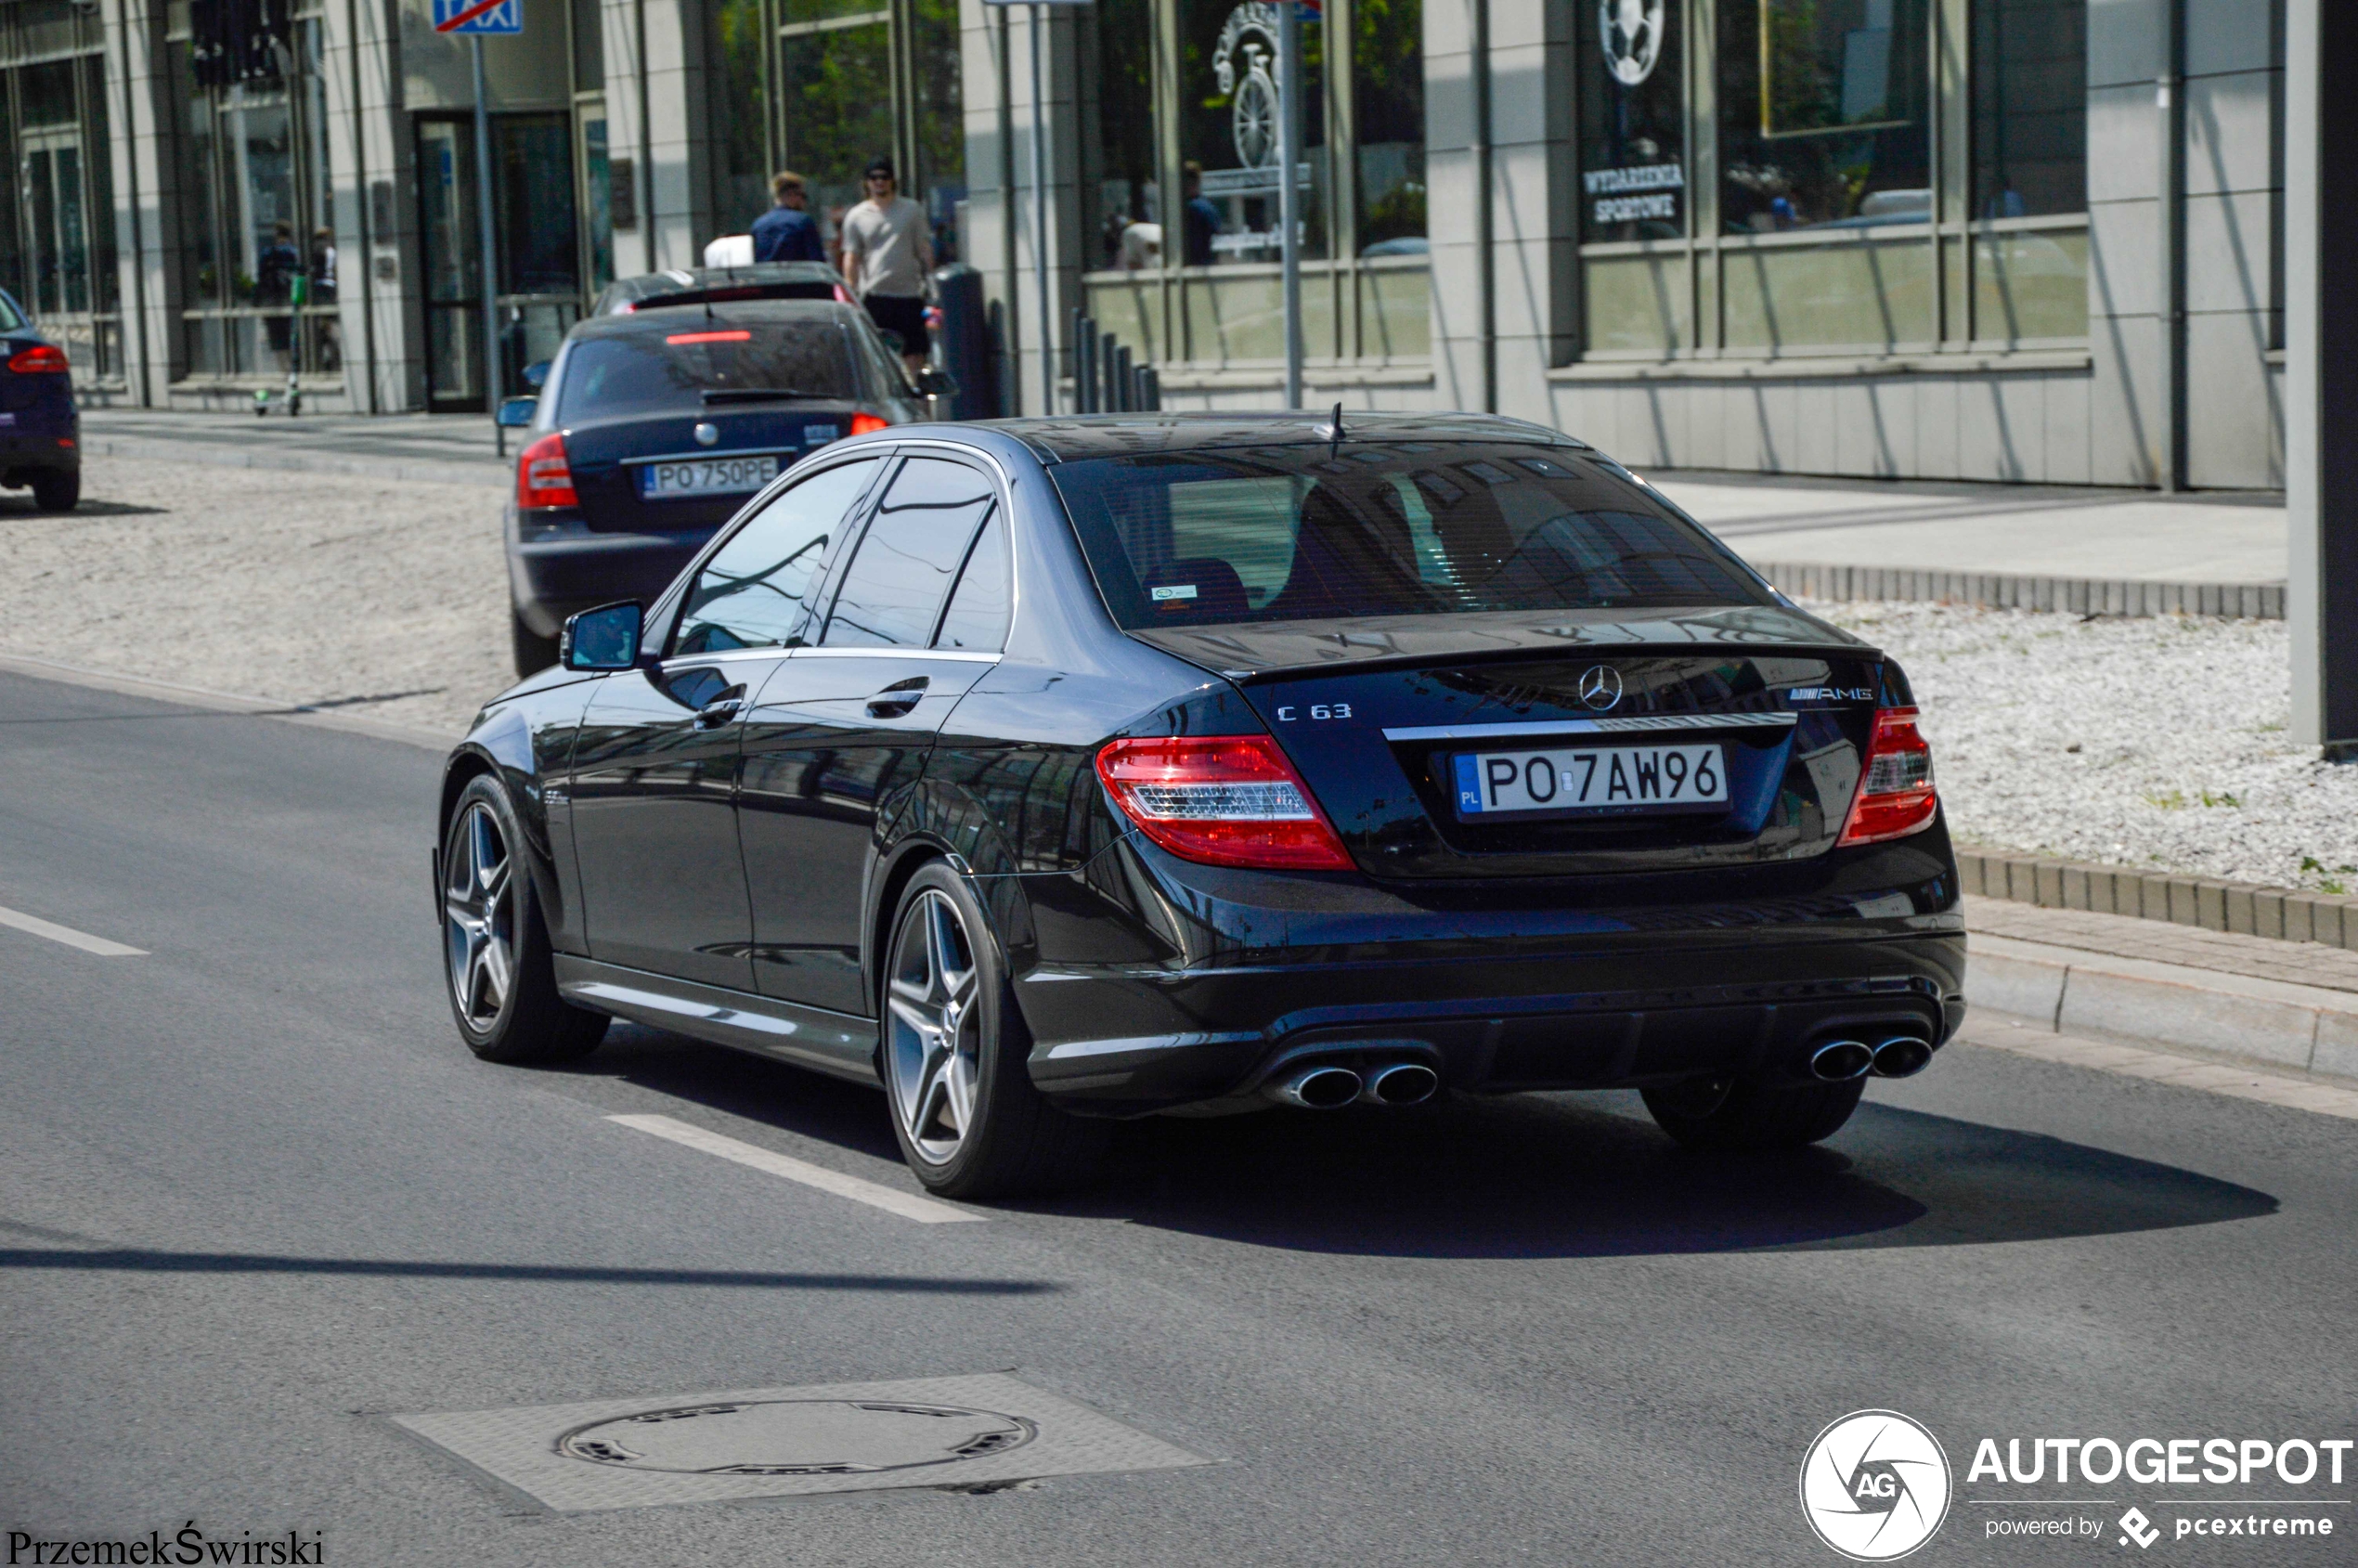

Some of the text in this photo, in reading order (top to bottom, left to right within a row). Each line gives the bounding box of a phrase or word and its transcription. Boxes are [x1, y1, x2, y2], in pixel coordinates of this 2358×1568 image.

[436, 0, 518, 28] TAXI
[1594, 193, 1675, 223] SPORTOWE
[658, 466, 693, 489] PO
[701, 460, 775, 486] 750PE
[1817, 687, 1873, 700] AMG
[1277, 704, 1352, 721] C 63
[1486, 750, 1717, 806] PO 7AW96
[1461, 792, 1479, 805] PL
